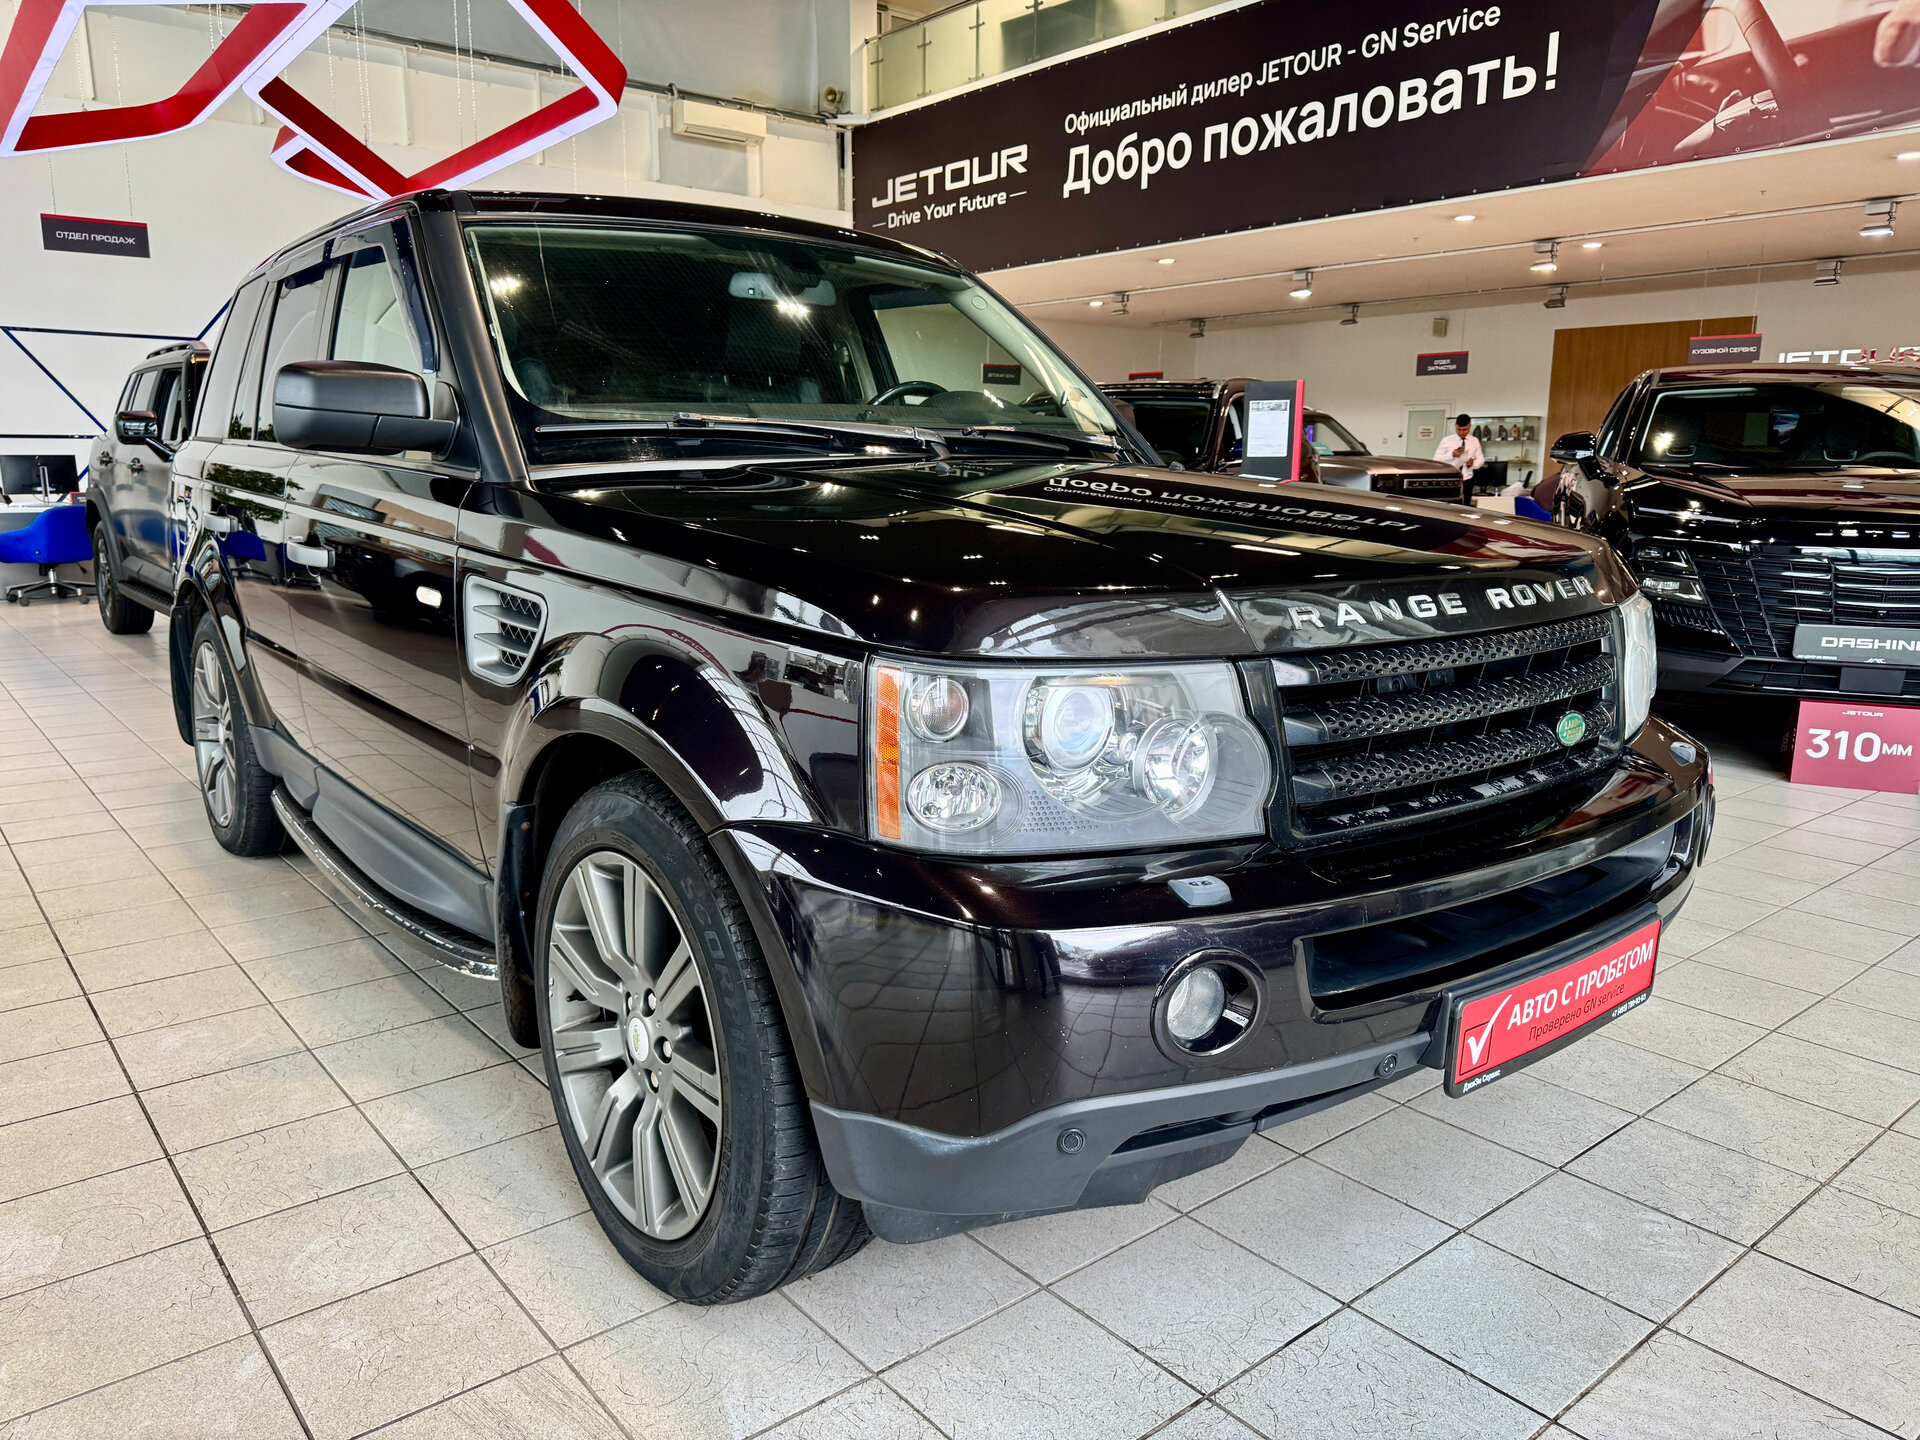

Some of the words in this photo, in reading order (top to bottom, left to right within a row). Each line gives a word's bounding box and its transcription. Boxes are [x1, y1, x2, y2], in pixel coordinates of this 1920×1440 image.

[1064, 82, 1188, 136] Официальный
[1190, 71, 1253, 106] дилер
[1256, 43, 1342, 87] JETOUR
[1361, 27, 1398, 58] GN
[1402, 5, 1501, 48] Service
[1062, 131, 1193, 199] Добро
[1203, 30, 1560, 163] пожаловать!
[871, 143, 1028, 209] JETOUR
[55, 230, 90, 241] ОТДЕЛ
[91, 233, 136, 245] ПРОДАЖ
[887, 204, 922, 229] Drive
[923, 202, 957, 221] Your
[959, 191, 1007, 214] Future
[1691, 346, 1729, 355] КУЗОВНОЙ
[1729, 345, 1758, 354] СЕРВИС
[1287, 592, 1468, 630] RANGE
[1484, 574, 1596, 611] ROVER
[1841, 710, 1884, 718] JETOUR
[1506, 988, 1558, 1031] АВТО
[1561, 981, 1574, 1006] С
[1574, 938, 1655, 1001] ПРОБЕГОМ
[1528, 1007, 1582, 1042] Проверено
[1583, 998, 1597, 1015] GN
[1597, 983, 1625, 1008] service
